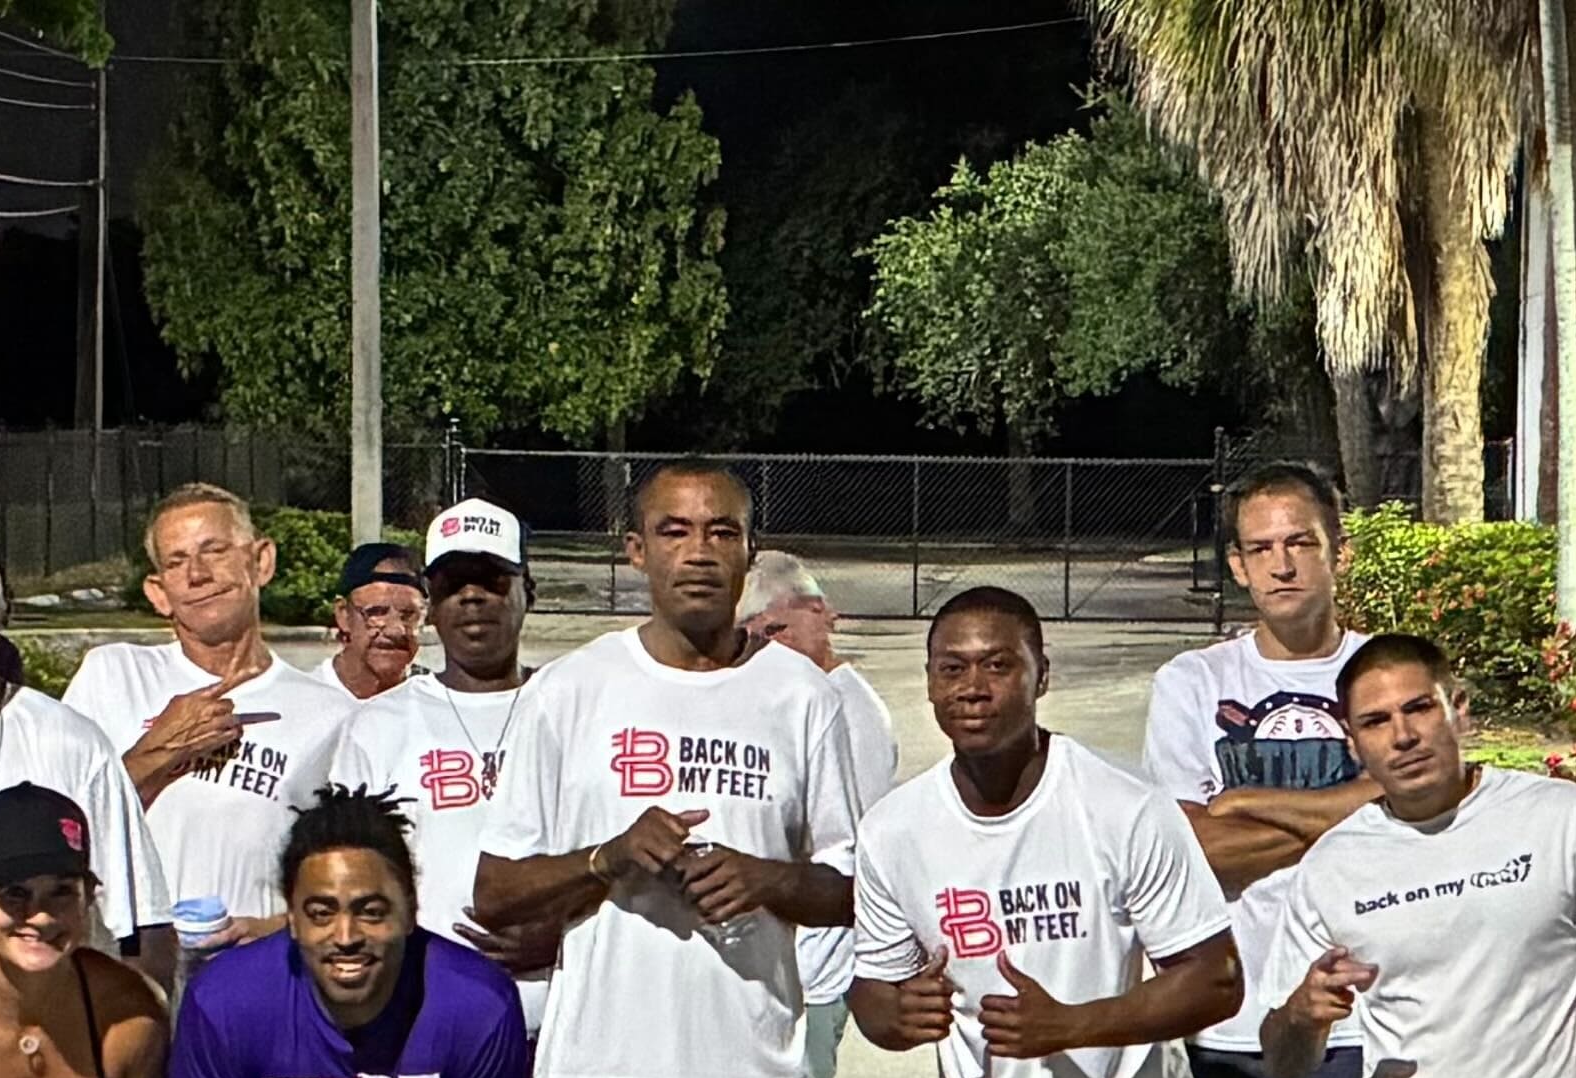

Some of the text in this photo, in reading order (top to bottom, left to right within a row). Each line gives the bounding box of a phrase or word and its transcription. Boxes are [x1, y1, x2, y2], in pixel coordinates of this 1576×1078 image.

[261, 747, 288, 776] ON
[679, 736, 771, 773] BACK ON
[677, 766, 774, 801] MY FEET.
[998, 880, 1082, 916] BACK ON
[1354, 878, 1465, 915] back on my
